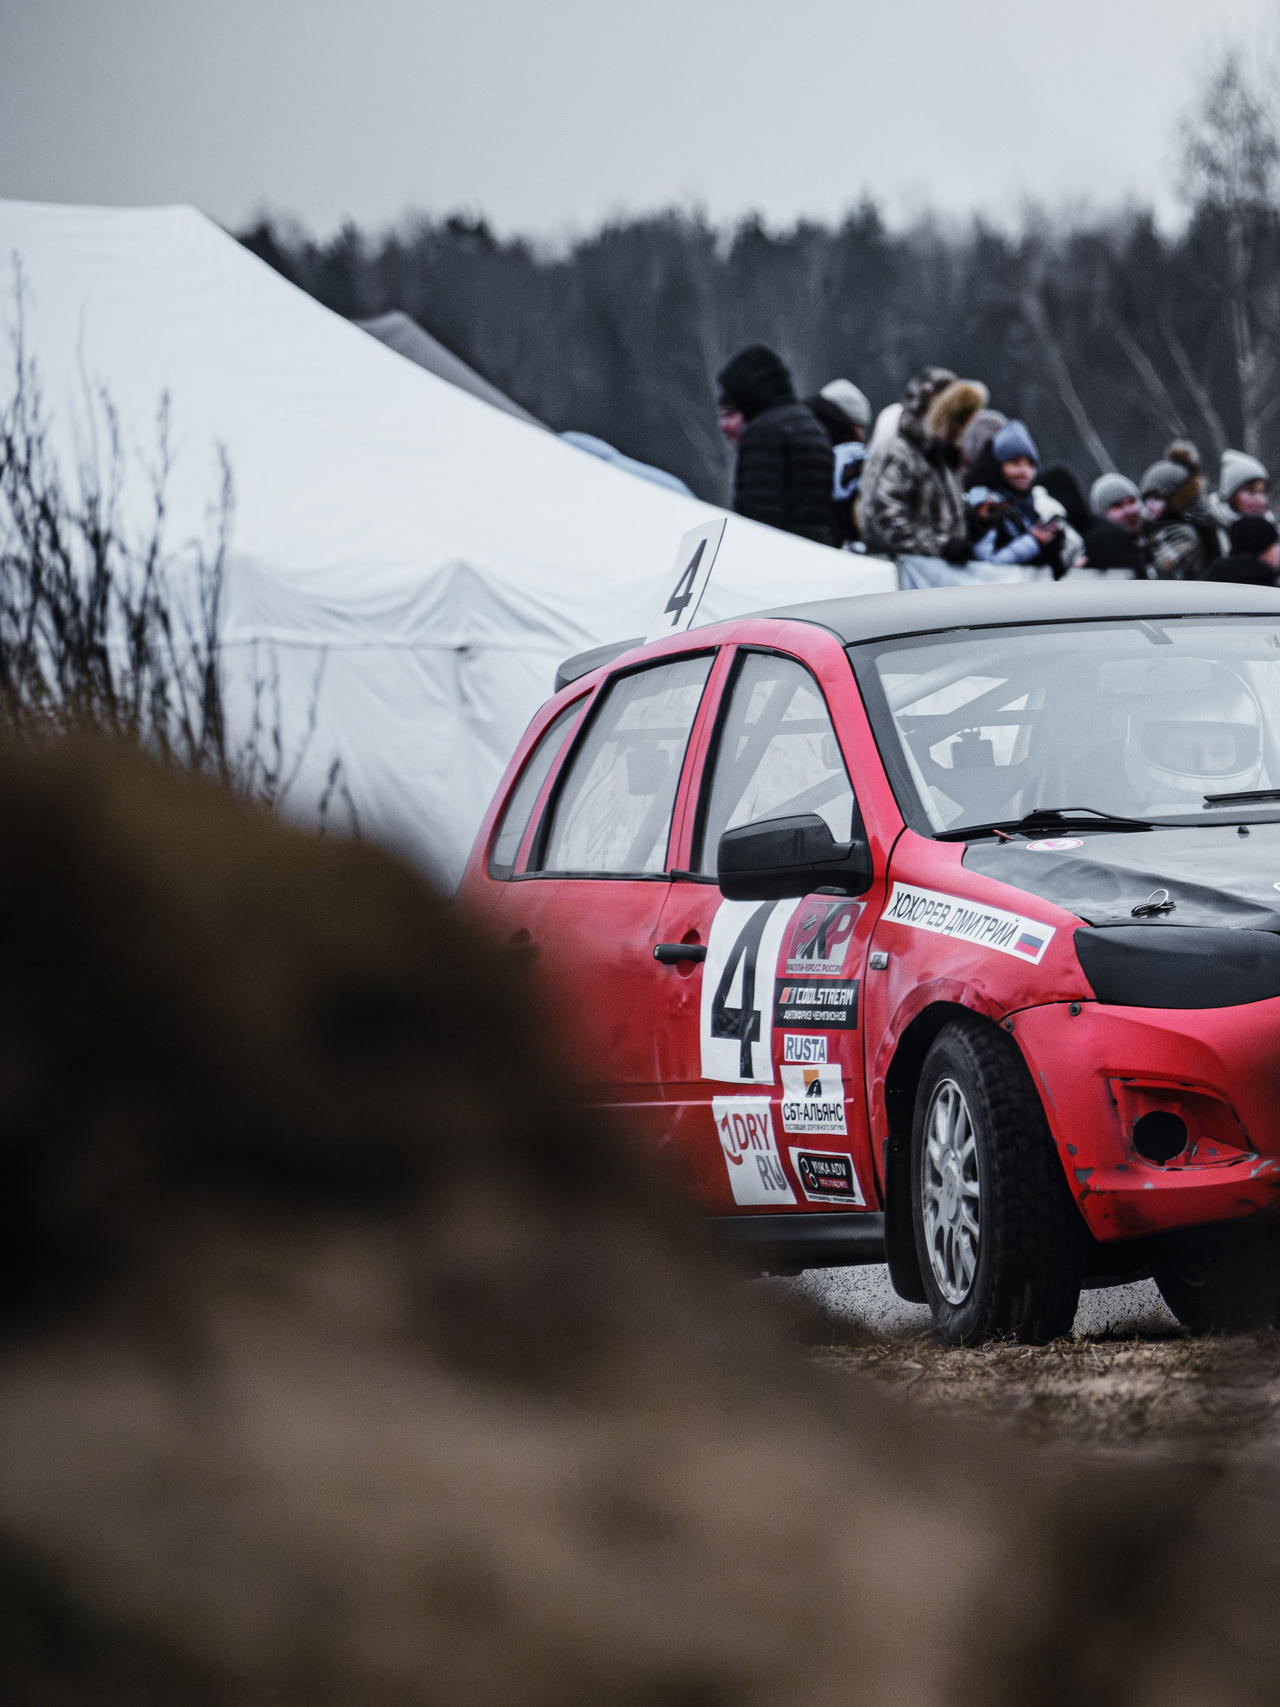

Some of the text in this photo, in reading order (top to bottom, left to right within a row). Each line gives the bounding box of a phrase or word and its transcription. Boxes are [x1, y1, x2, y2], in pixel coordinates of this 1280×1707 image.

[663, 538, 708, 627] 4
[887, 891, 1020, 947] ХОХОРЕВ ДМИТРИЙ
[710, 900, 781, 1079] 4
[795, 987, 854, 1006] COOLSTREAM
[785, 1036, 826, 1062] RUSTA
[782, 1102, 844, 1122] СБТ-АЛЬЯНС
[755, 1154, 788, 1191] RU
[831, 1162, 847, 1176] ADV
